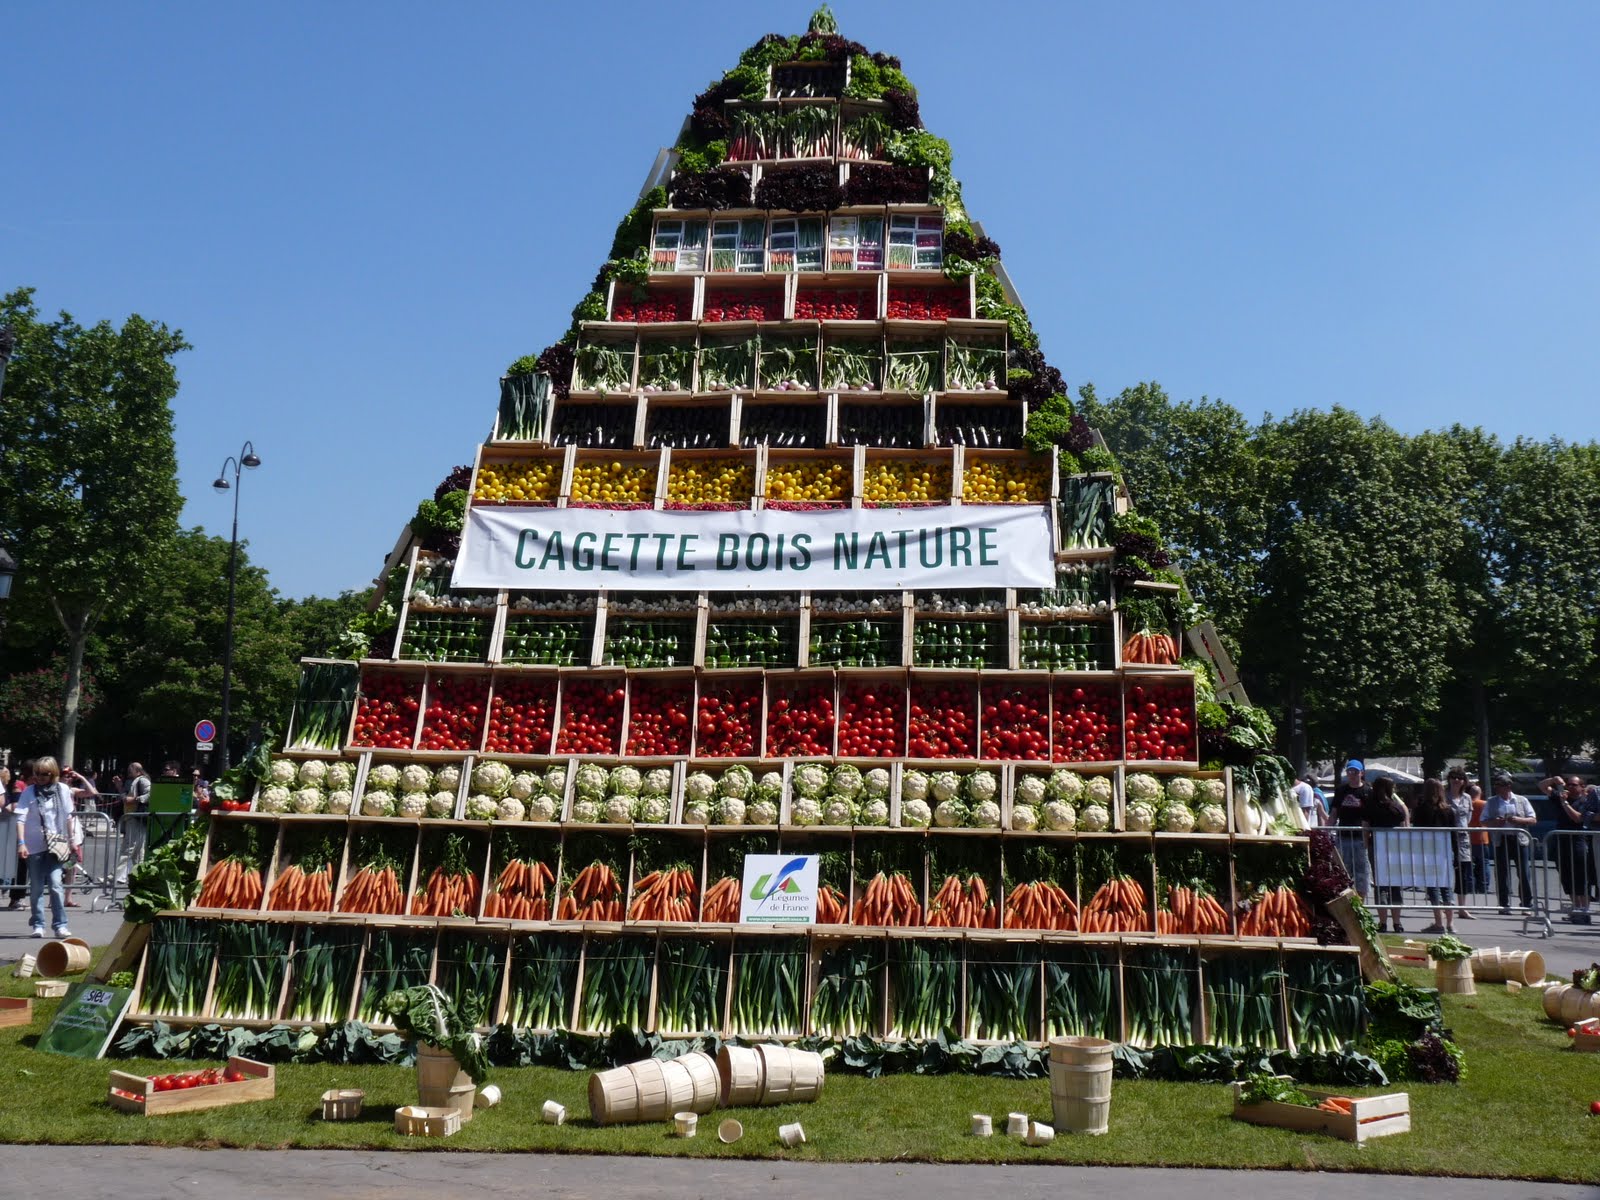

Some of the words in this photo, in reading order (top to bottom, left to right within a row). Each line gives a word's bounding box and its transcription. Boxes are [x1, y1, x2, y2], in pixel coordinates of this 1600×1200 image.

[514, 528, 699, 571] CAGETTE
[716, 533, 812, 571] BOIS
[833, 526, 999, 570] NATURE
[769, 903, 780, 911] de
[782, 903, 809, 911] France
